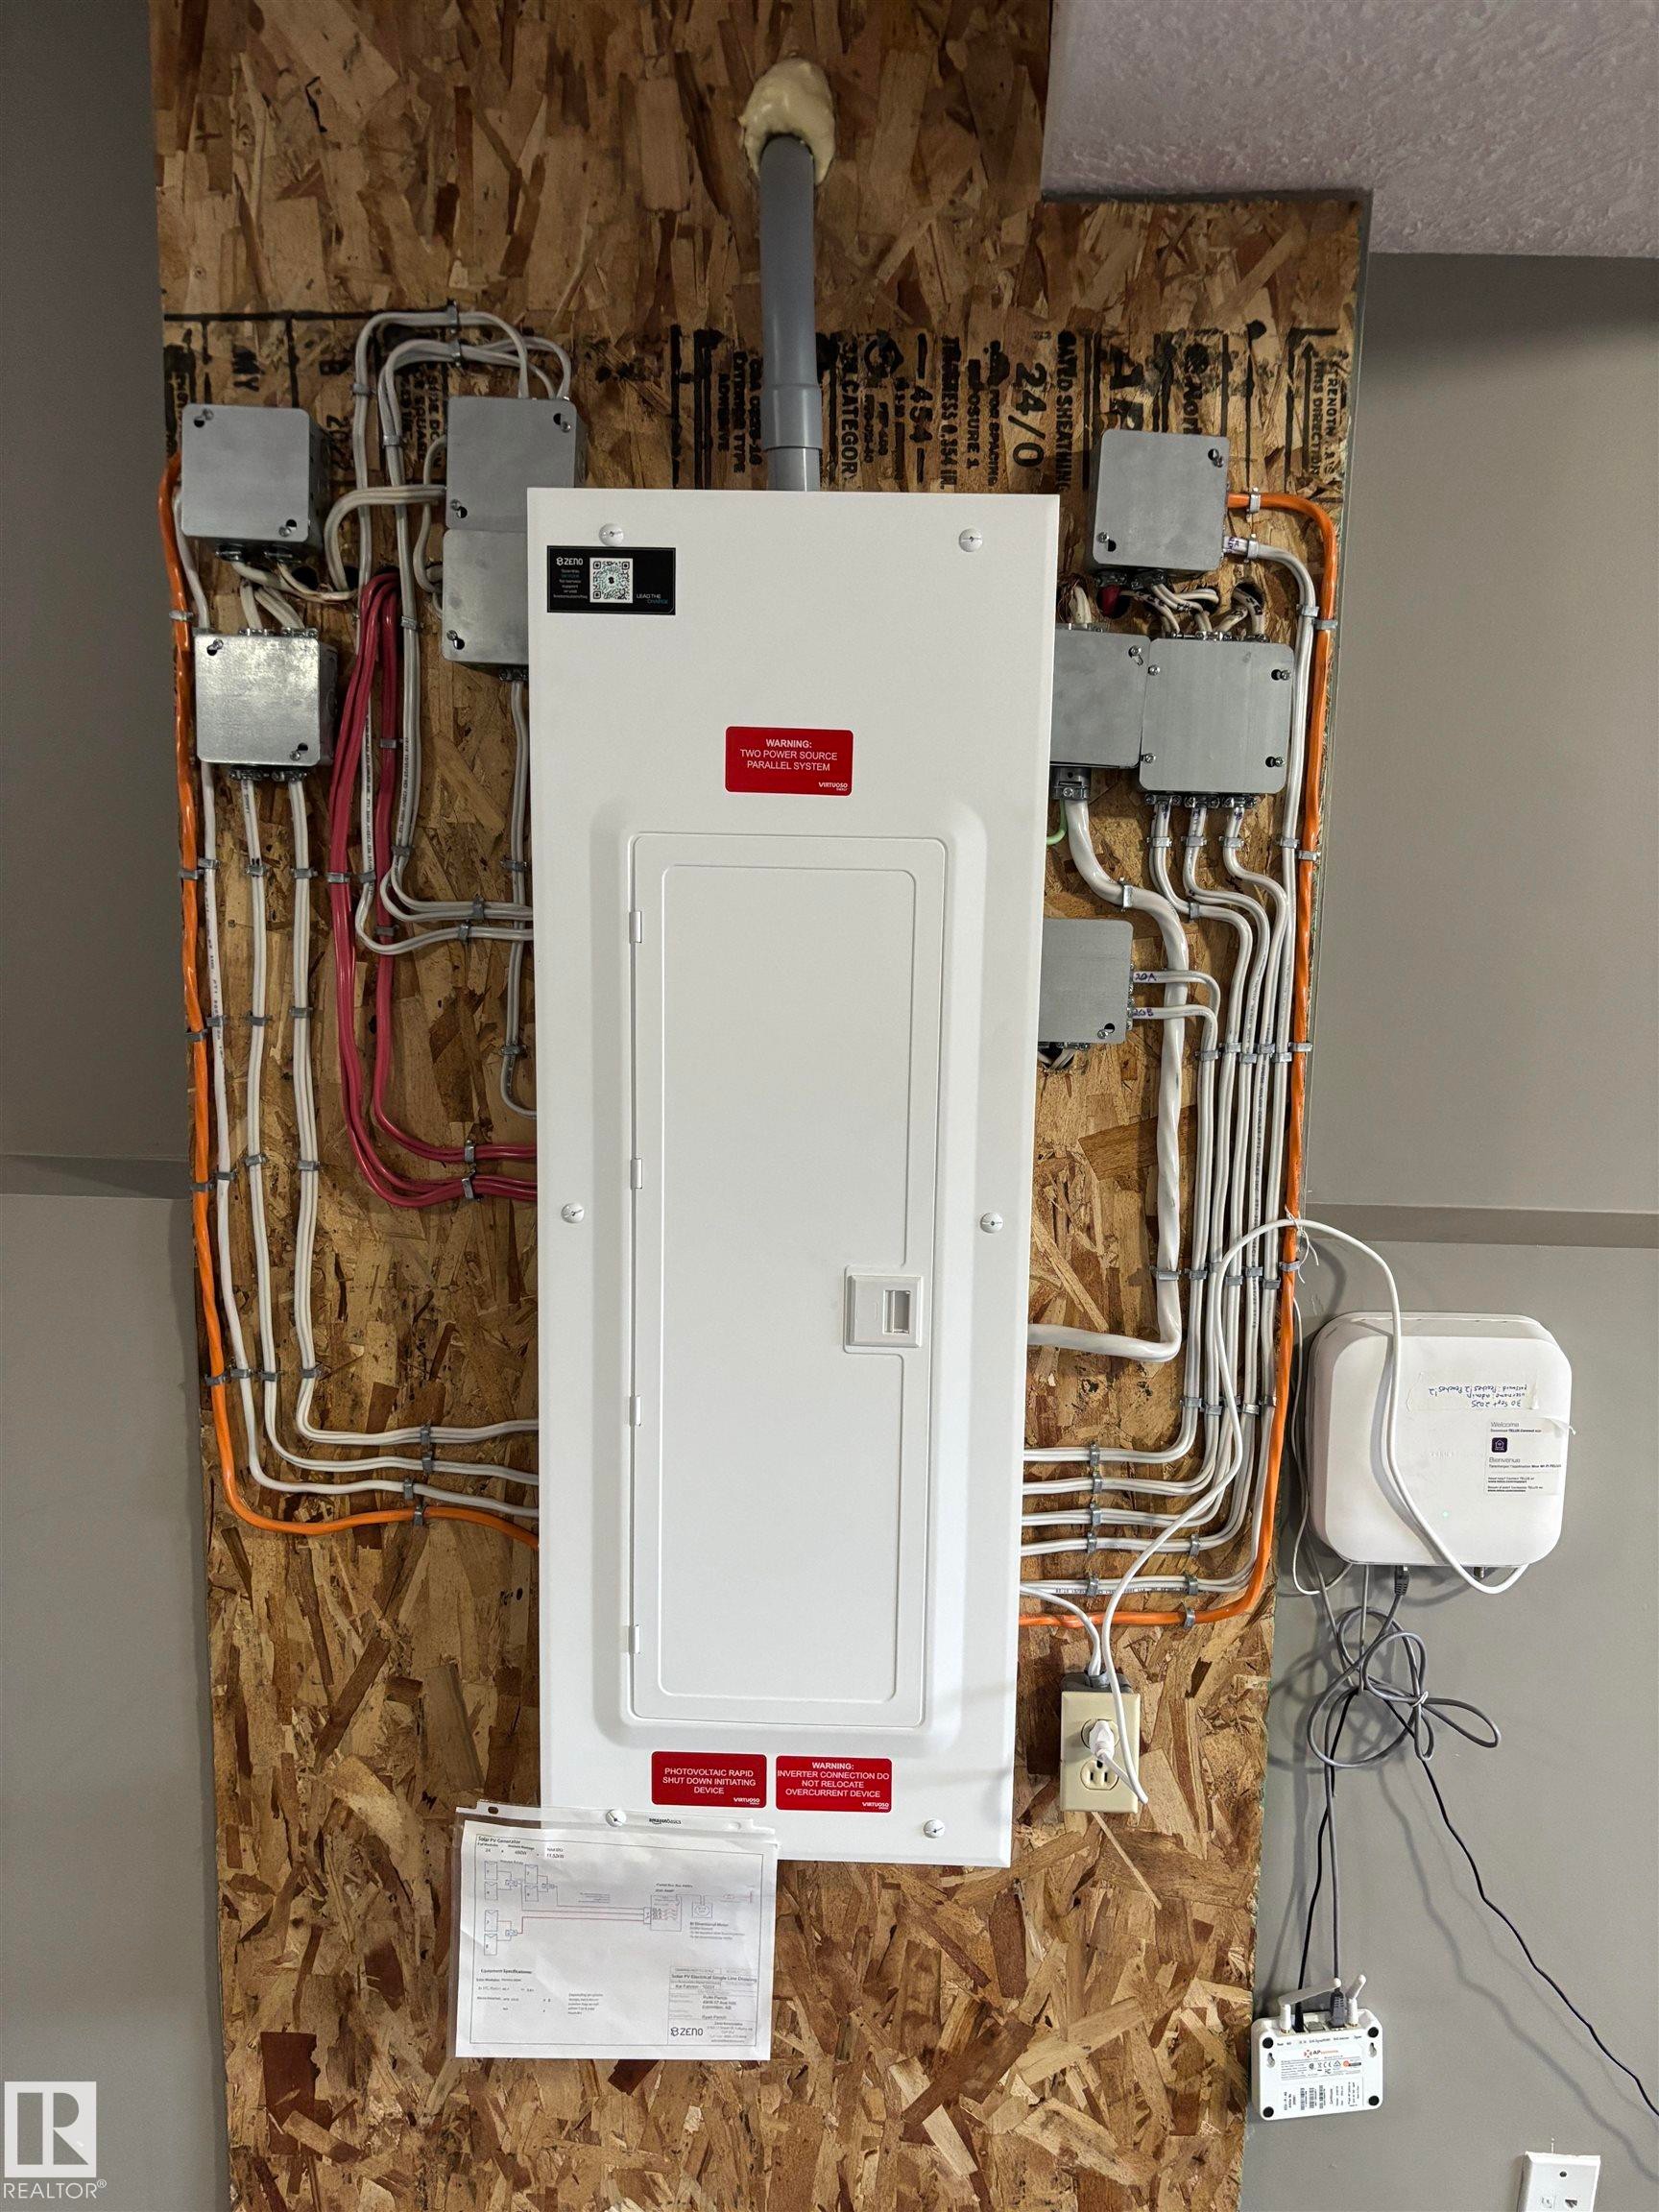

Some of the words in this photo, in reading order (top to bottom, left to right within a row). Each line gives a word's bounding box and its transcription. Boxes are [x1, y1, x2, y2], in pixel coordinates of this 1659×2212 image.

[910, 385, 933, 443] 454
[1008, 362, 1048, 468] 24/0
[841, 381, 859, 480] CATEGOR
[1055, 395, 1073, 493] SHEATHING
[733, 433, 746, 473] TYPE
[564, 557, 584, 565] ZENO
[765, 738, 812, 749] WARNING:
[740, 749, 761, 758] TWO
[763, 750, 797, 759] POWER
[799, 751, 837, 761] SOURCE
[747, 760, 792, 770] PARALLEL
[793, 761, 830, 772] SYSTEM
[1135, 972, 1157, 981] 20A
[1471, 1400, 1490, 1408] 2025
[811, 1762, 854, 1770] WARNING:
[664, 1767, 727, 1777] PHOTOVOLTAIC
[729, 1769, 755, 1778] RAPID
[777, 1769, 818, 1779] INVERTER
[820, 1770, 875, 1780] CONNECTION
[877, 1772, 890, 1781] DO
[662, 1776, 685, 1785] SHUT
[686, 1777, 712, 1786] DOWN
[714, 1777, 757, 1787] INITIATING
[821, 1780, 864, 1789] RELOCATE
[693, 1786, 725, 1794] DEVICE
[785, 1788, 848, 1797] OVERCURRENT
[850, 1790, 881, 1798] DEVICE
[680, 2028, 703, 2036] ZENO
